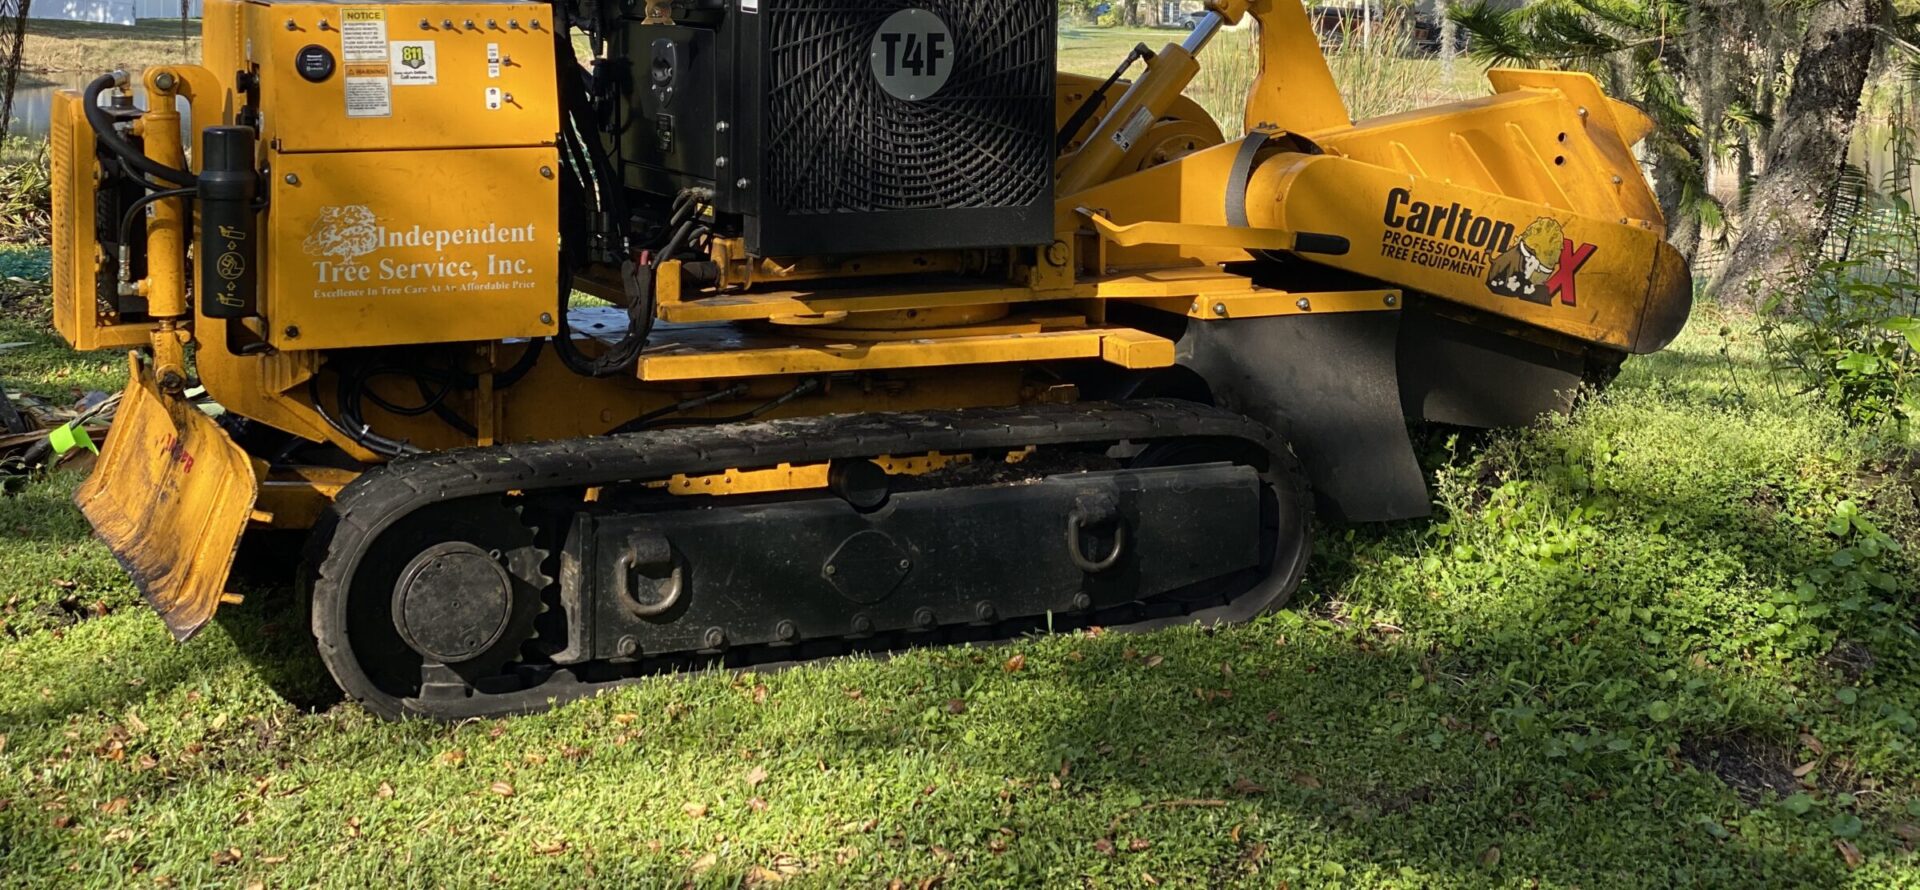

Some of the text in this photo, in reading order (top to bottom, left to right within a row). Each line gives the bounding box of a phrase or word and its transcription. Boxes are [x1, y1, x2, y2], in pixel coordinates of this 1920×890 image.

[347, 12, 381, 20] NOTICE
[402, 46, 423, 61] 811
[881, 33, 945, 76] T4F
[1384, 187, 1514, 254] Carlton
[378, 223, 535, 252] Independent
[1382, 230, 1487, 265] PROFESSIONAL
[312, 253, 533, 283] Tree Service, Inc.
[1381, 244, 1485, 278] TREE EQUIPMENT
[313, 288, 365, 298] Excellence
[367, 287, 377, 296] In
[381, 286, 402, 295] Tree
[404, 285, 428, 294] Care
[431, 285, 441, 293] At
[460, 281, 510, 292] Affordable
[512, 280, 536, 289] Price
